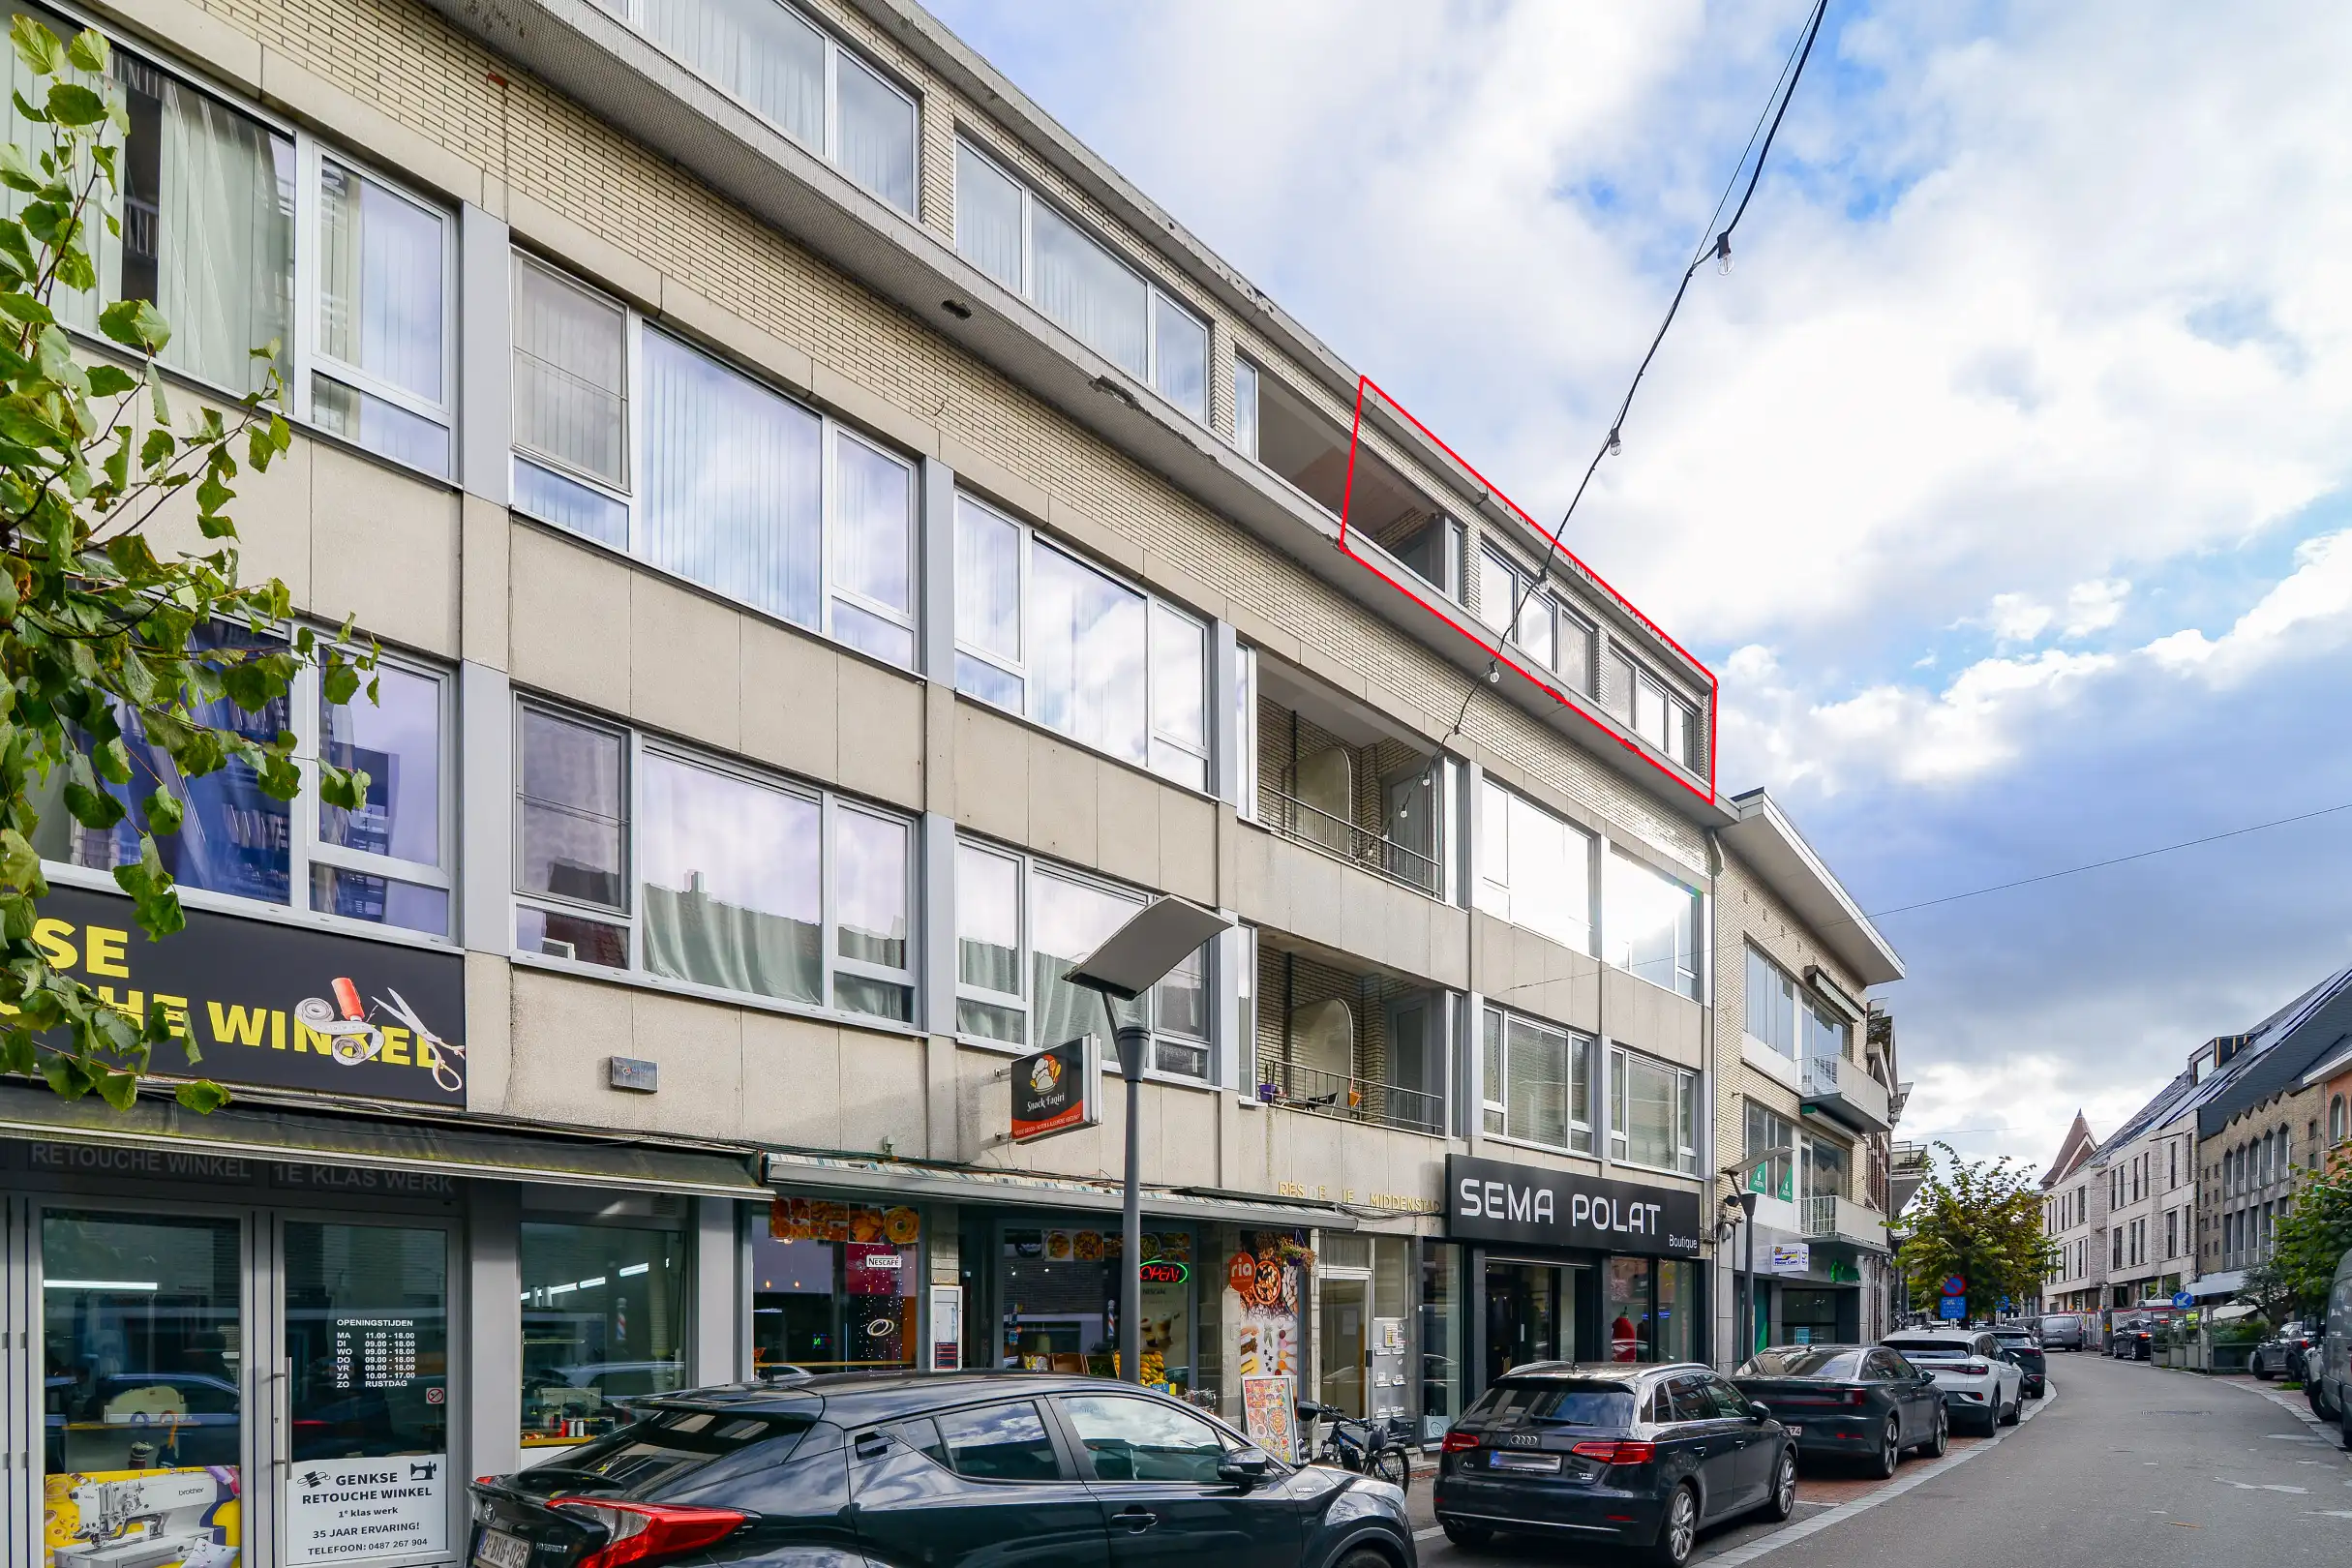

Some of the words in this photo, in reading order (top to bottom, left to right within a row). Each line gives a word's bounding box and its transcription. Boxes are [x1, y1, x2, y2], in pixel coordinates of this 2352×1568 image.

[1027, 1097, 1046, 1112] Snack
[31, 1142, 163, 1171] RETOUCHE
[166, 1153, 251, 1178] WINKEL
[312, 1165, 377, 1188] KLAS
[384, 1171, 454, 1193] WERK
[1370, 1193, 1441, 1213] MIDDENSTAD
[1460, 1178, 1554, 1224] SEMA
[1571, 1193, 1661, 1235] POLAT
[1669, 1234, 1698, 1250] Boutique
[1140, 1265, 1180, 1282] OPEN
[1231, 1257, 1252, 1278] ria
[336, 1472, 398, 1487] GENKSE
[178, 1487, 204, 1496] brother
[302, 1490, 377, 1504] RETOUCHE
[380, 1487, 432, 1499] WINKEL
[350, 1508, 372, 1518] klas
[374, 1506, 398, 1516] werk
[313, 1529, 326, 1539] 35
[329, 1527, 358, 1538] JAAR
[361, 1522, 420, 1535] ERVARING!
[308, 1543, 367, 1555] TELEFOON:
[368, 1541, 390, 1551] 0487
[392, 1540, 409, 1549] 267
[411, 1538, 428, 1547] 904
